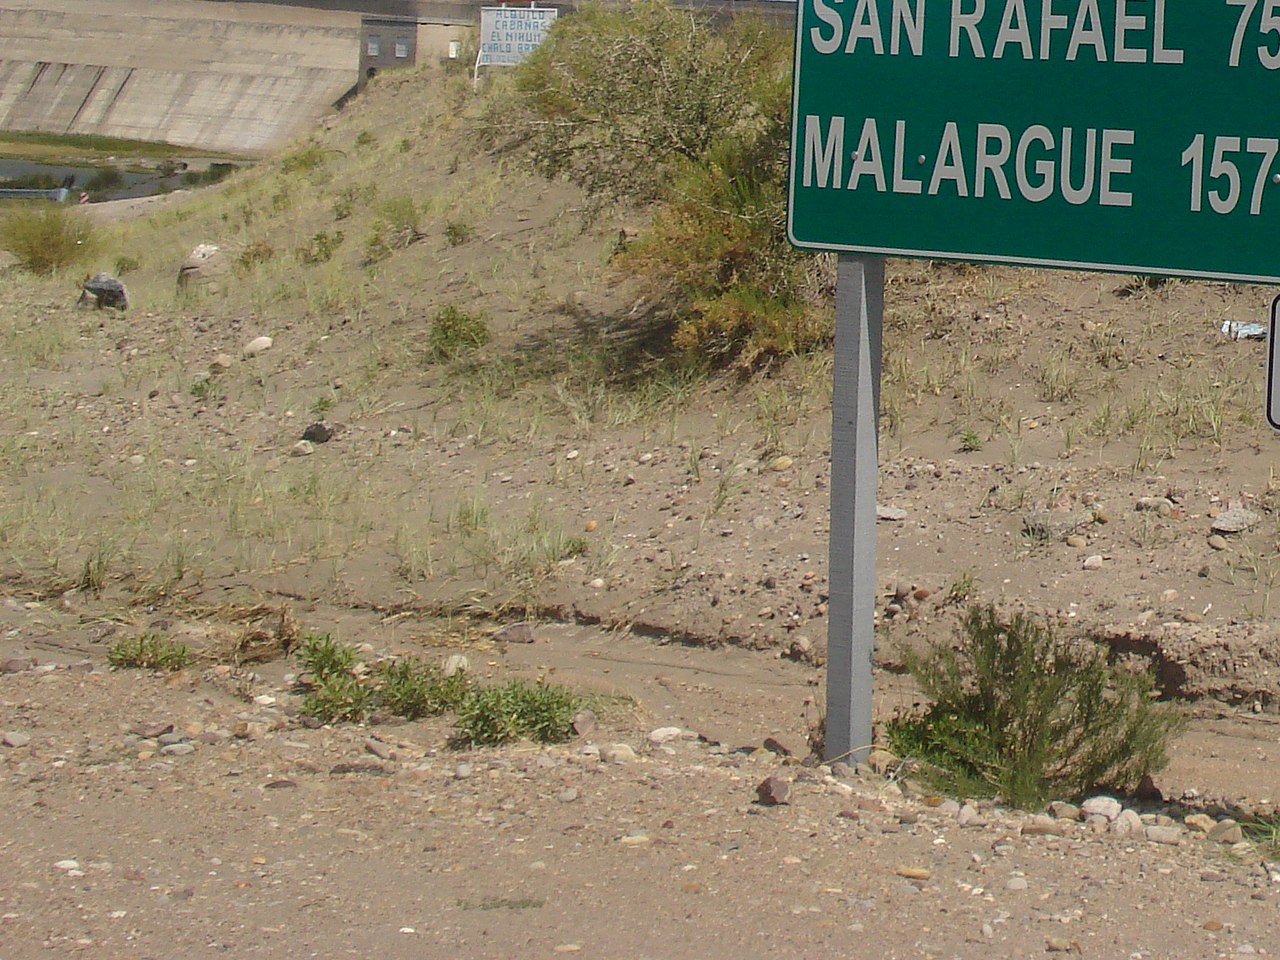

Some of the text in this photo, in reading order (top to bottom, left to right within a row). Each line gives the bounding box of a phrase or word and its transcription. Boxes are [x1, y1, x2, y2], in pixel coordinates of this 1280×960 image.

[496, 10, 544, 19] ALQUILO
[491, 31, 502, 41] EL
[802, 114, 1280, 216] MALARGUE 157
